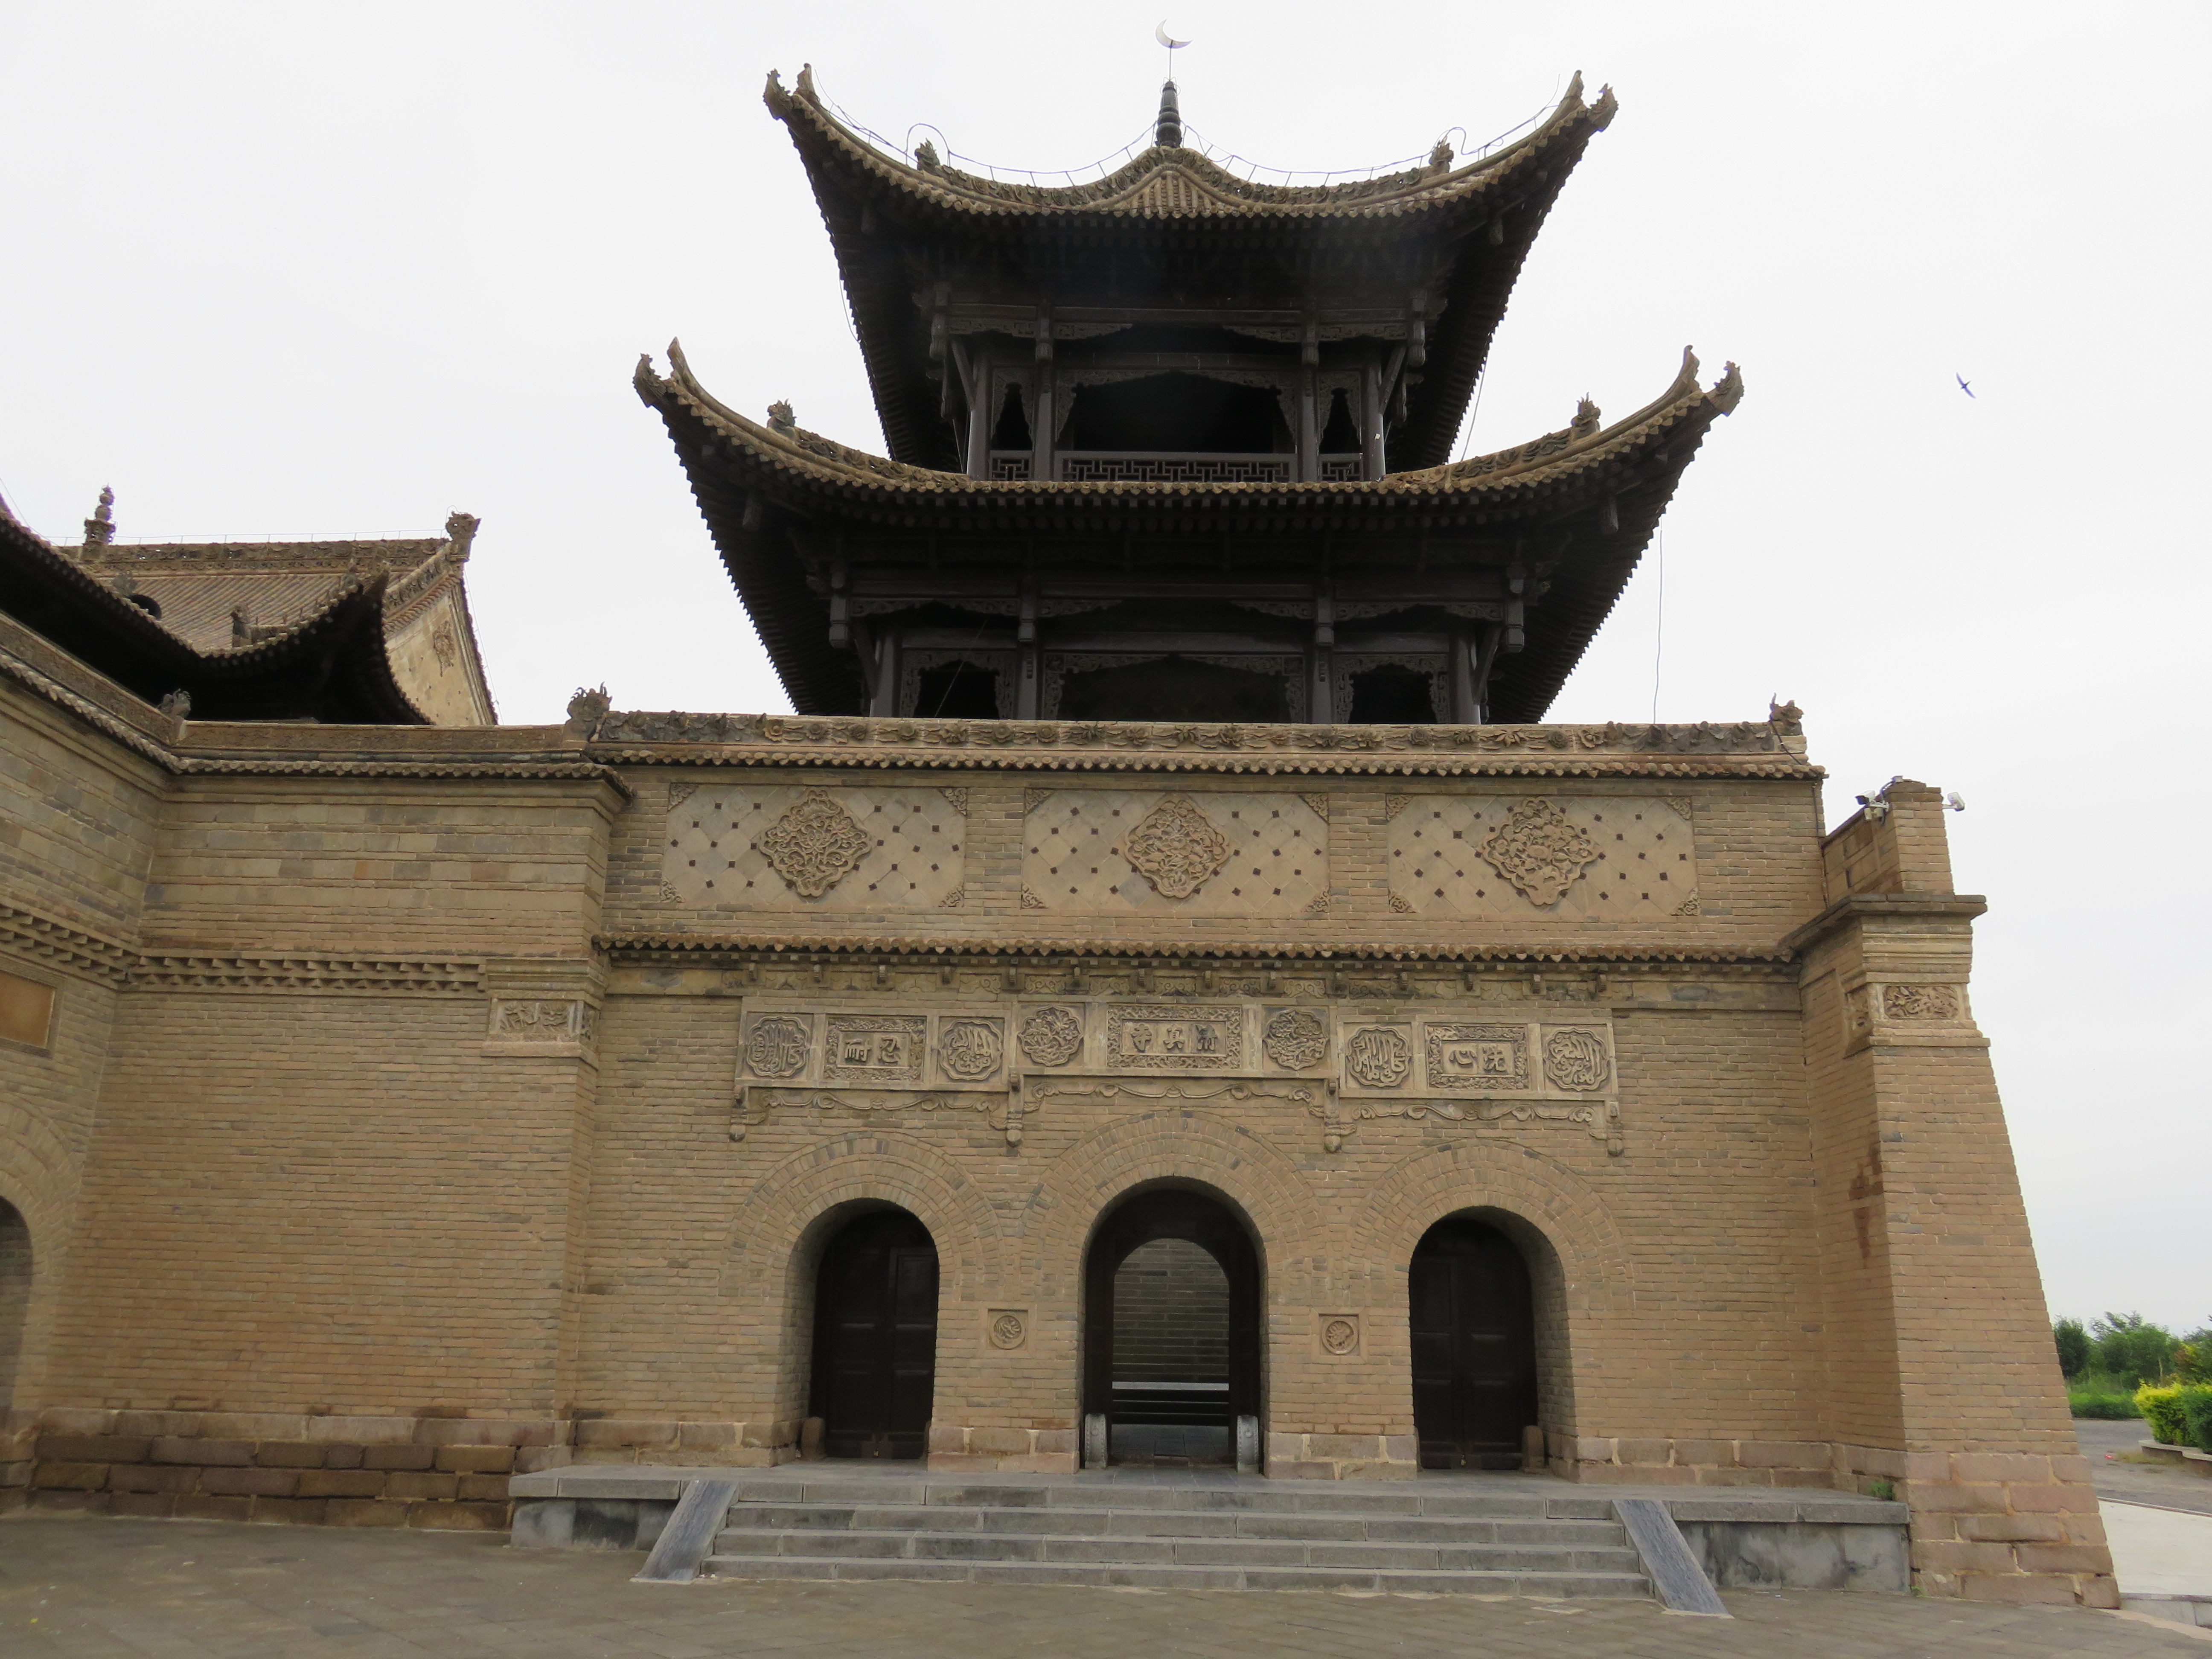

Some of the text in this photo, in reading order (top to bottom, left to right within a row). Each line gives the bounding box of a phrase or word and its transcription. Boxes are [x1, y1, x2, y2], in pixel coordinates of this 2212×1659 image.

[844, 1036, 902, 1063] 忍耐
[1130, 1023, 1218, 1051] 清真寺
[1449, 1046, 1507, 1072] 洗心
